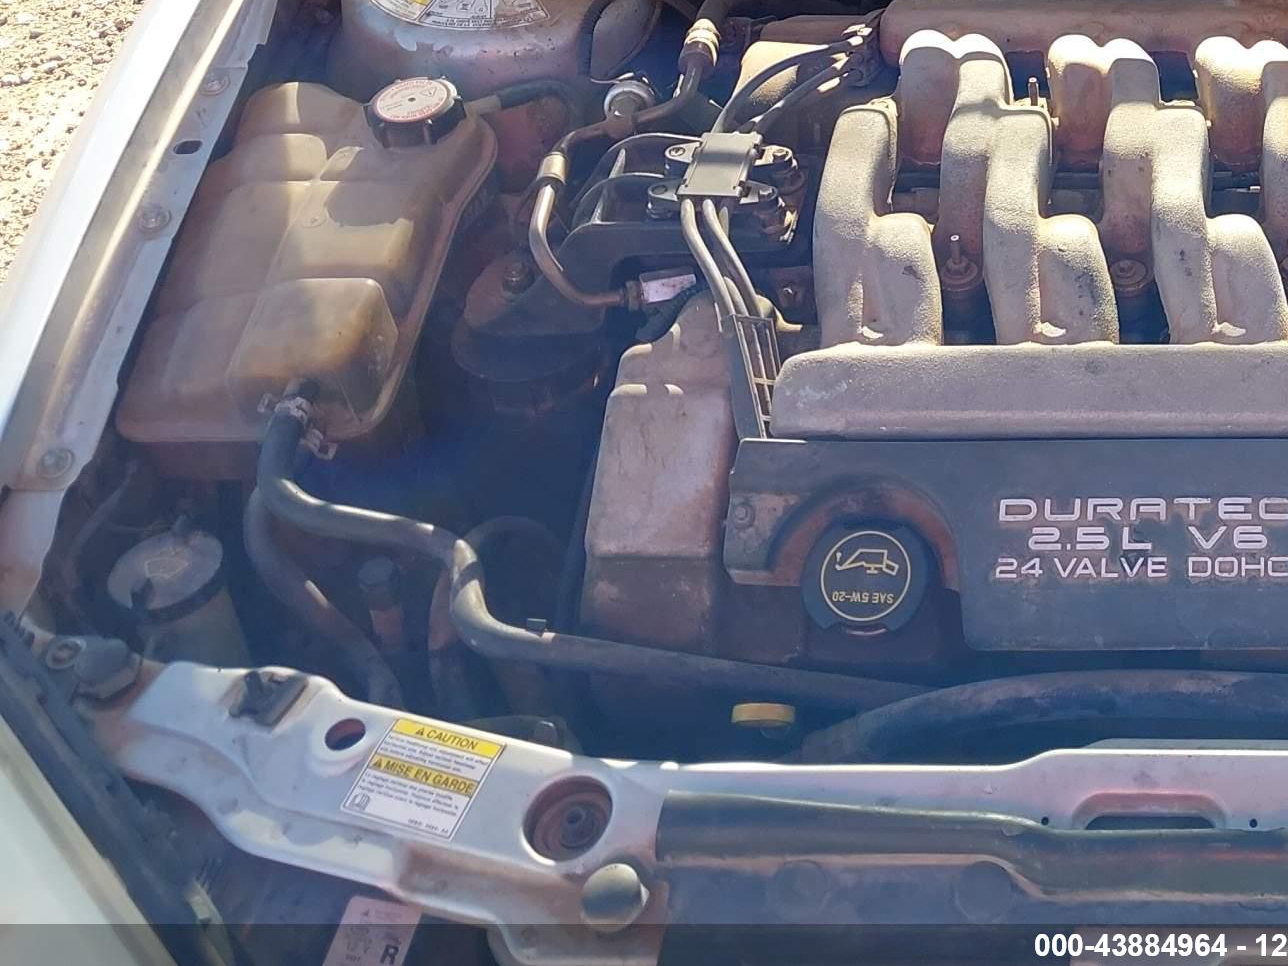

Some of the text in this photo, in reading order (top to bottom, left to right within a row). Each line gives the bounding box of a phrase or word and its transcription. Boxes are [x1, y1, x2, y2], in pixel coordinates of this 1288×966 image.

[1187, 525, 1268, 550] V6
[995, 557, 1043, 579] 24
[1054, 557, 1168, 578] VALVE
[832, 591, 895, 604] SAE 5W-20
[426, 730, 478, 749] CAUTION
[384, 760, 475, 793] MISE EN GARDE
[380, 944, 400, 965] R
